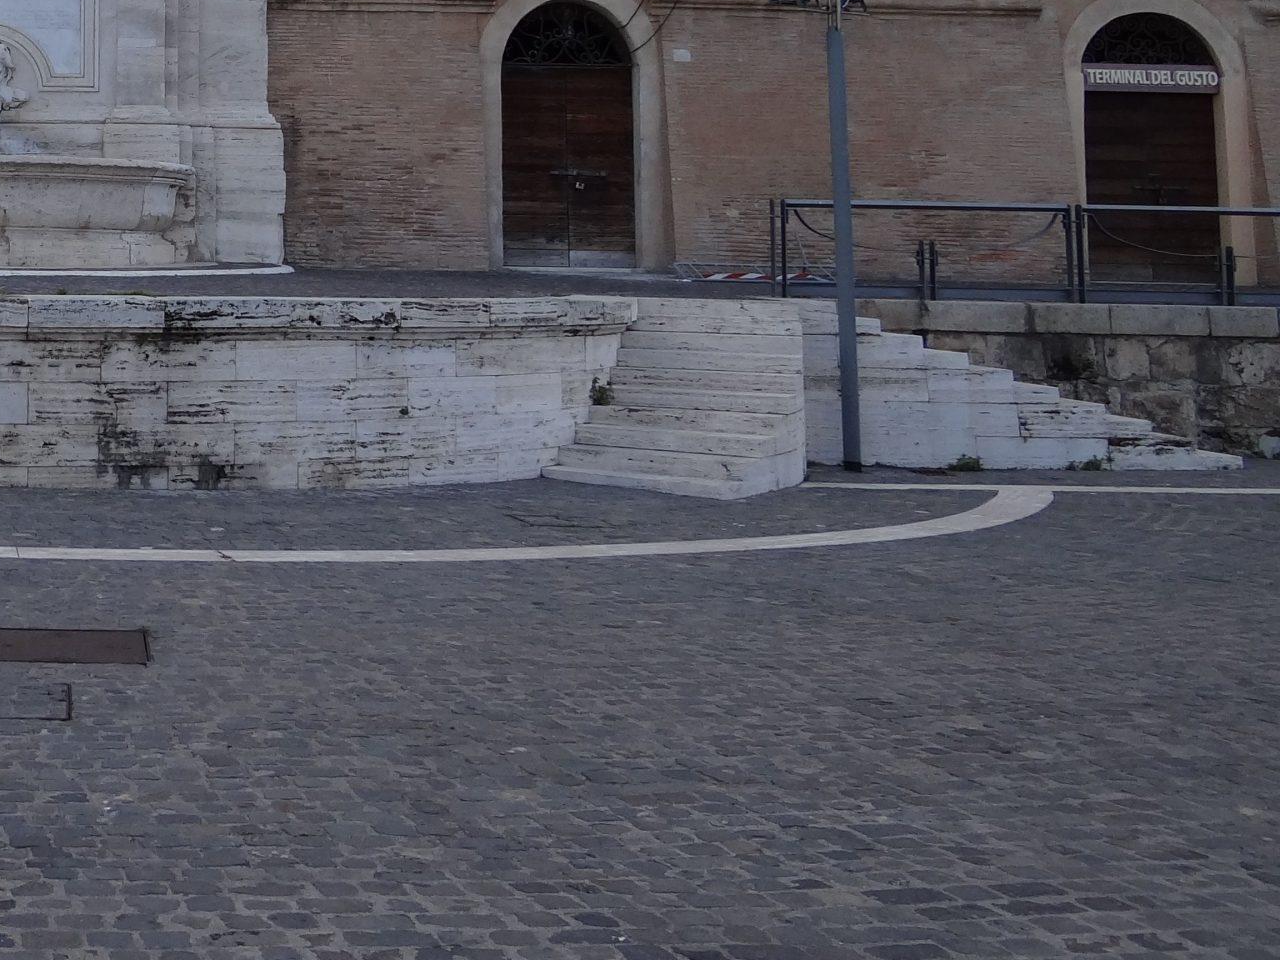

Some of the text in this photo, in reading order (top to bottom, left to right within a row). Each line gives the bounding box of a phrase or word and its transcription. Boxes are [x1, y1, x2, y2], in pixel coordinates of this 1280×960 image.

[1085, 69, 1219, 86] TERMINAL DEL GUSTO
